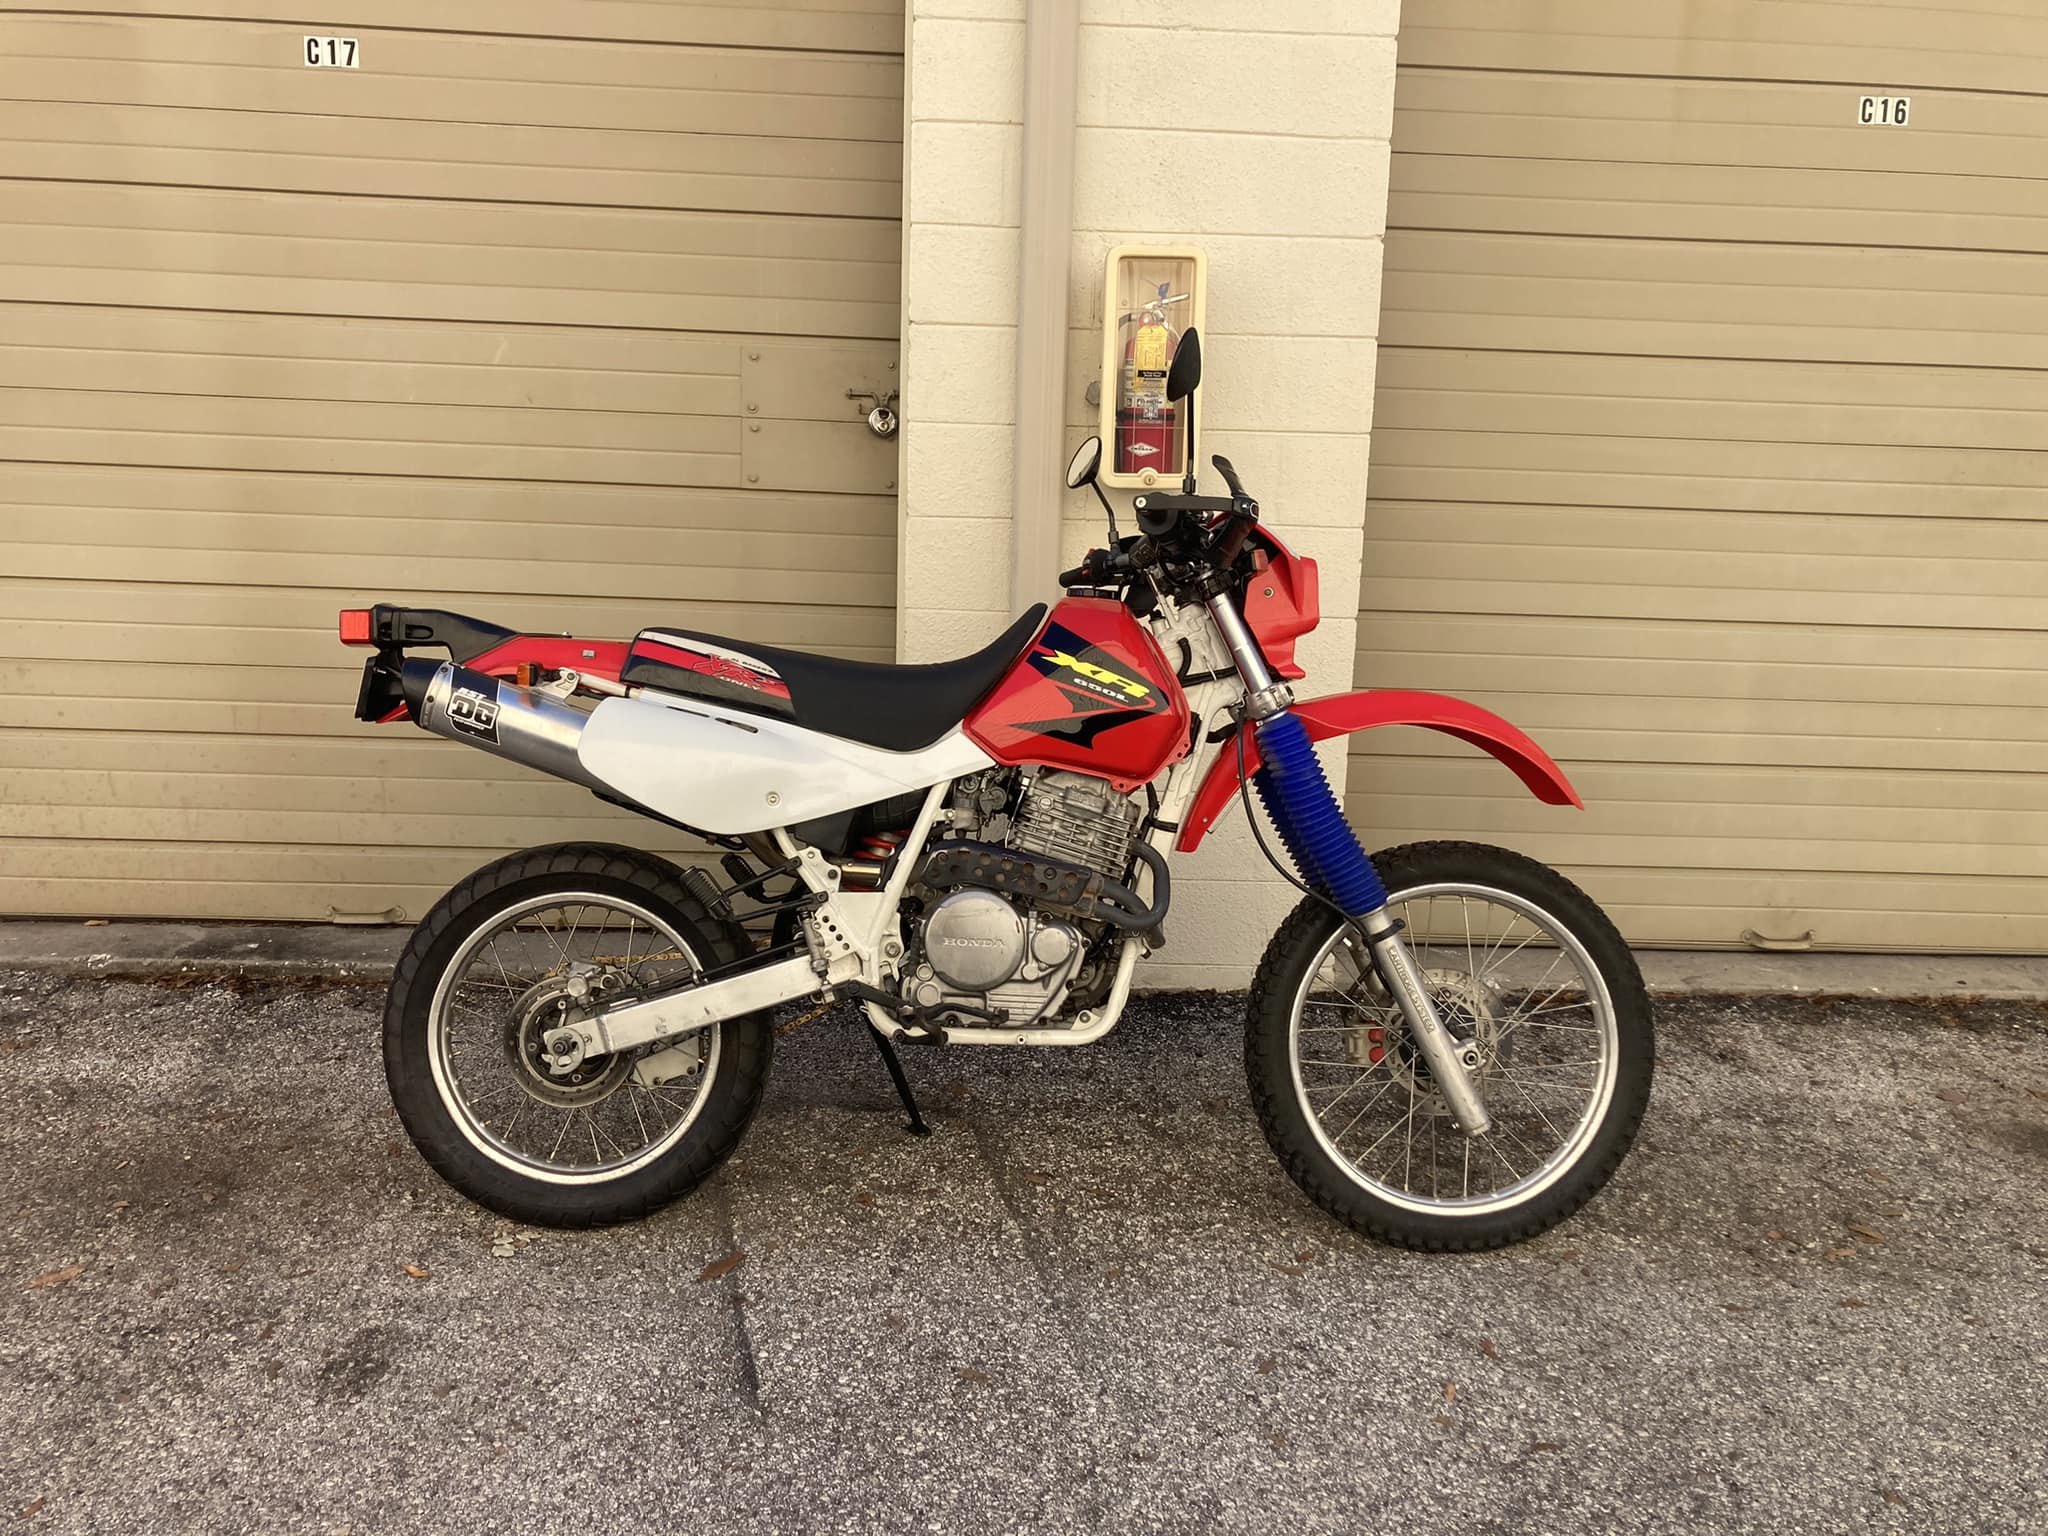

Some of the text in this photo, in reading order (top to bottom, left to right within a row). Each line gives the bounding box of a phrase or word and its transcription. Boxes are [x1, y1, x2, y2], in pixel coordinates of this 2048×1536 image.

[306, 38, 356, 66] C17
[1861, 97, 1907, 124] C16
[1072, 677, 1129, 703] 650L
[450, 693, 497, 728] DG
[943, 936, 1006, 949] HONDA
